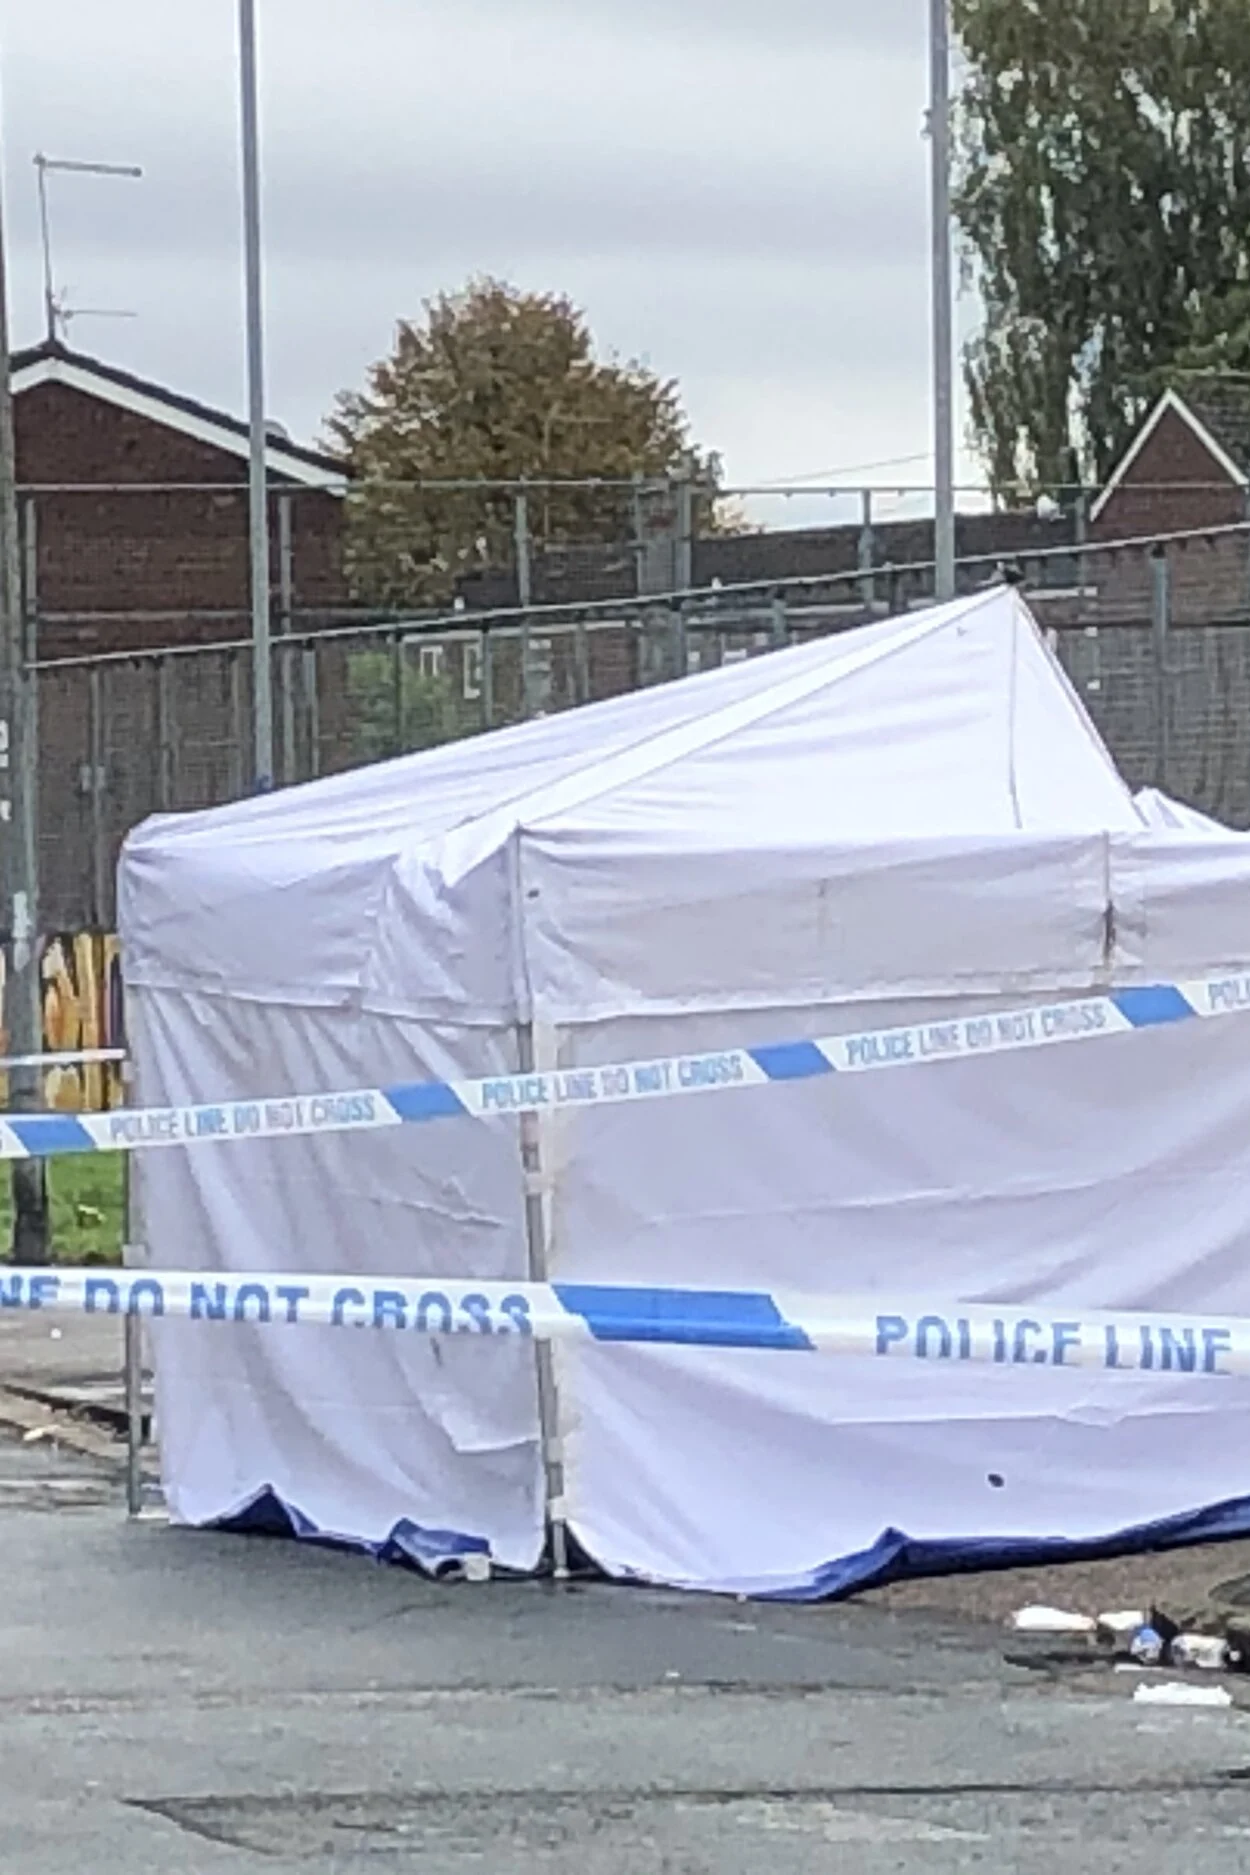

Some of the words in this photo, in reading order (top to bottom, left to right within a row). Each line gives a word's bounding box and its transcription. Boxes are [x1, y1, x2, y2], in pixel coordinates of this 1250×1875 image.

[846, 1031, 914, 1066] POLICE
[481, 1075, 549, 1109] POLICE
[109, 1109, 178, 1143] POLICE
[84, 1278, 164, 1316] DO
[190, 1281, 310, 1324] NOT
[331, 1287, 534, 1337] CROSS
[874, 1314, 1081, 1367] POLICE
[1105, 1324, 1232, 1376] LINE
